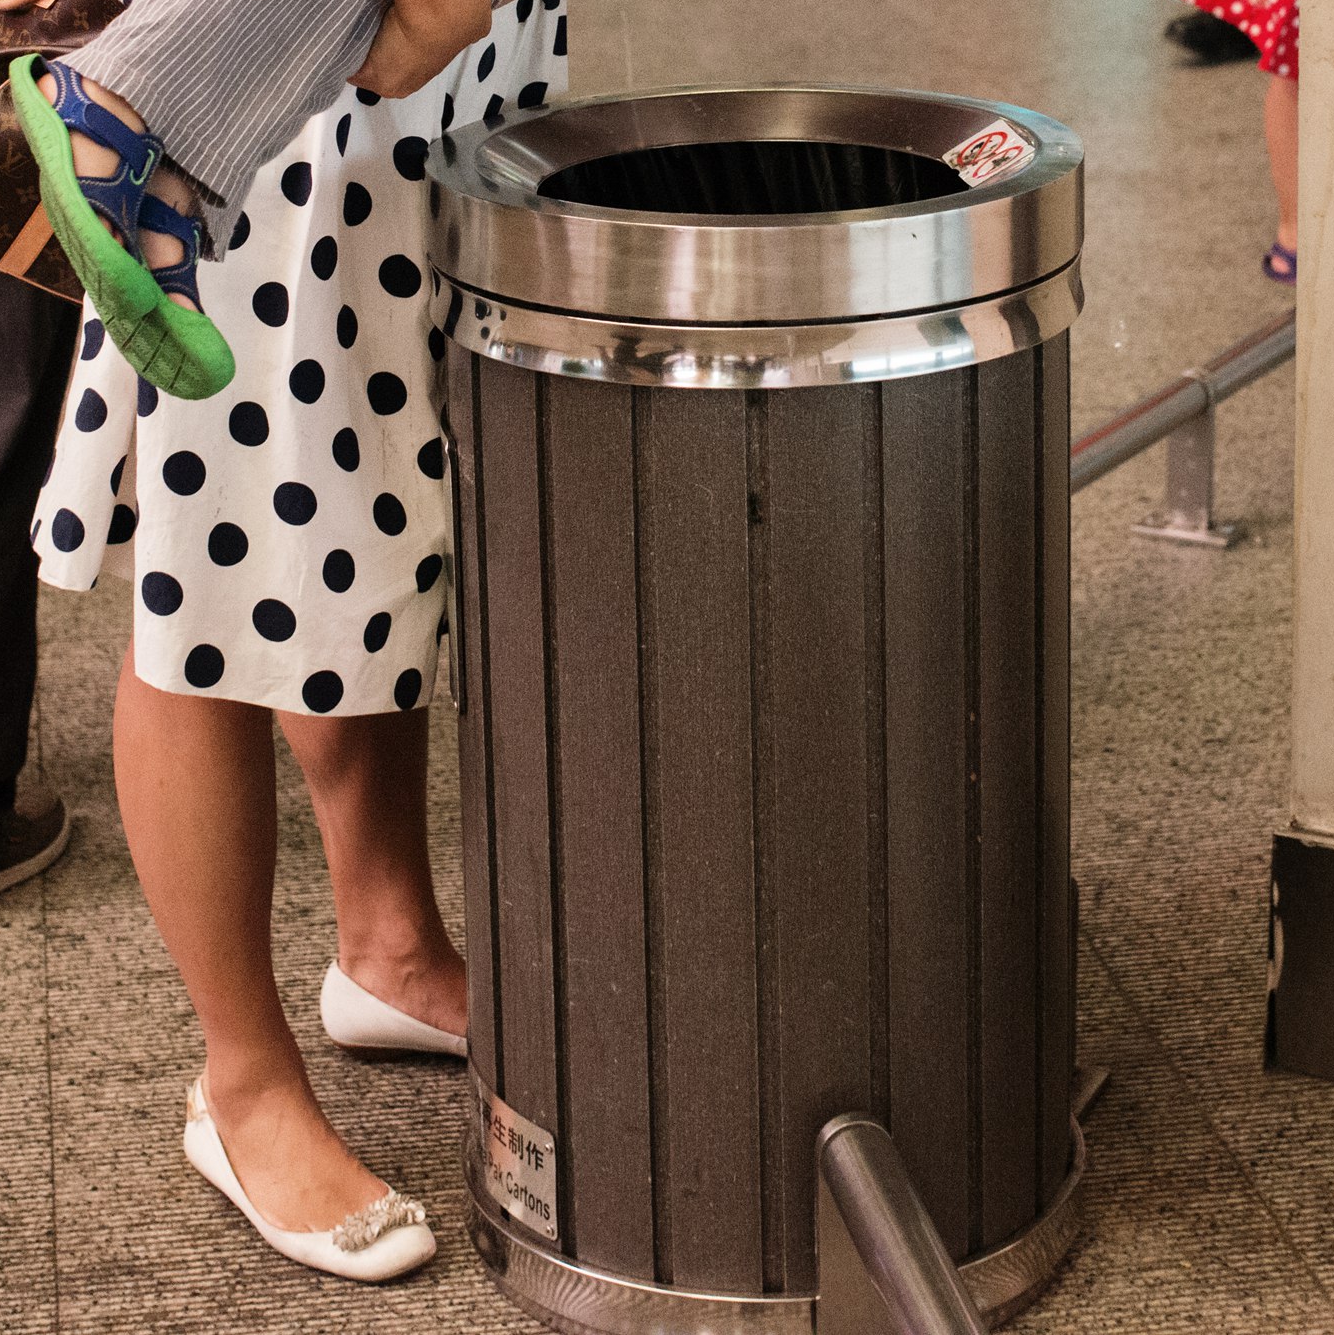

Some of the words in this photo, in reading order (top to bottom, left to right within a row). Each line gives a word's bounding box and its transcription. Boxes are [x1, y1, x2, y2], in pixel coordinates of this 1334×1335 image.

[484, 1108, 544, 1171] 生制作
[506, 1171, 551, 1221] Cartons
